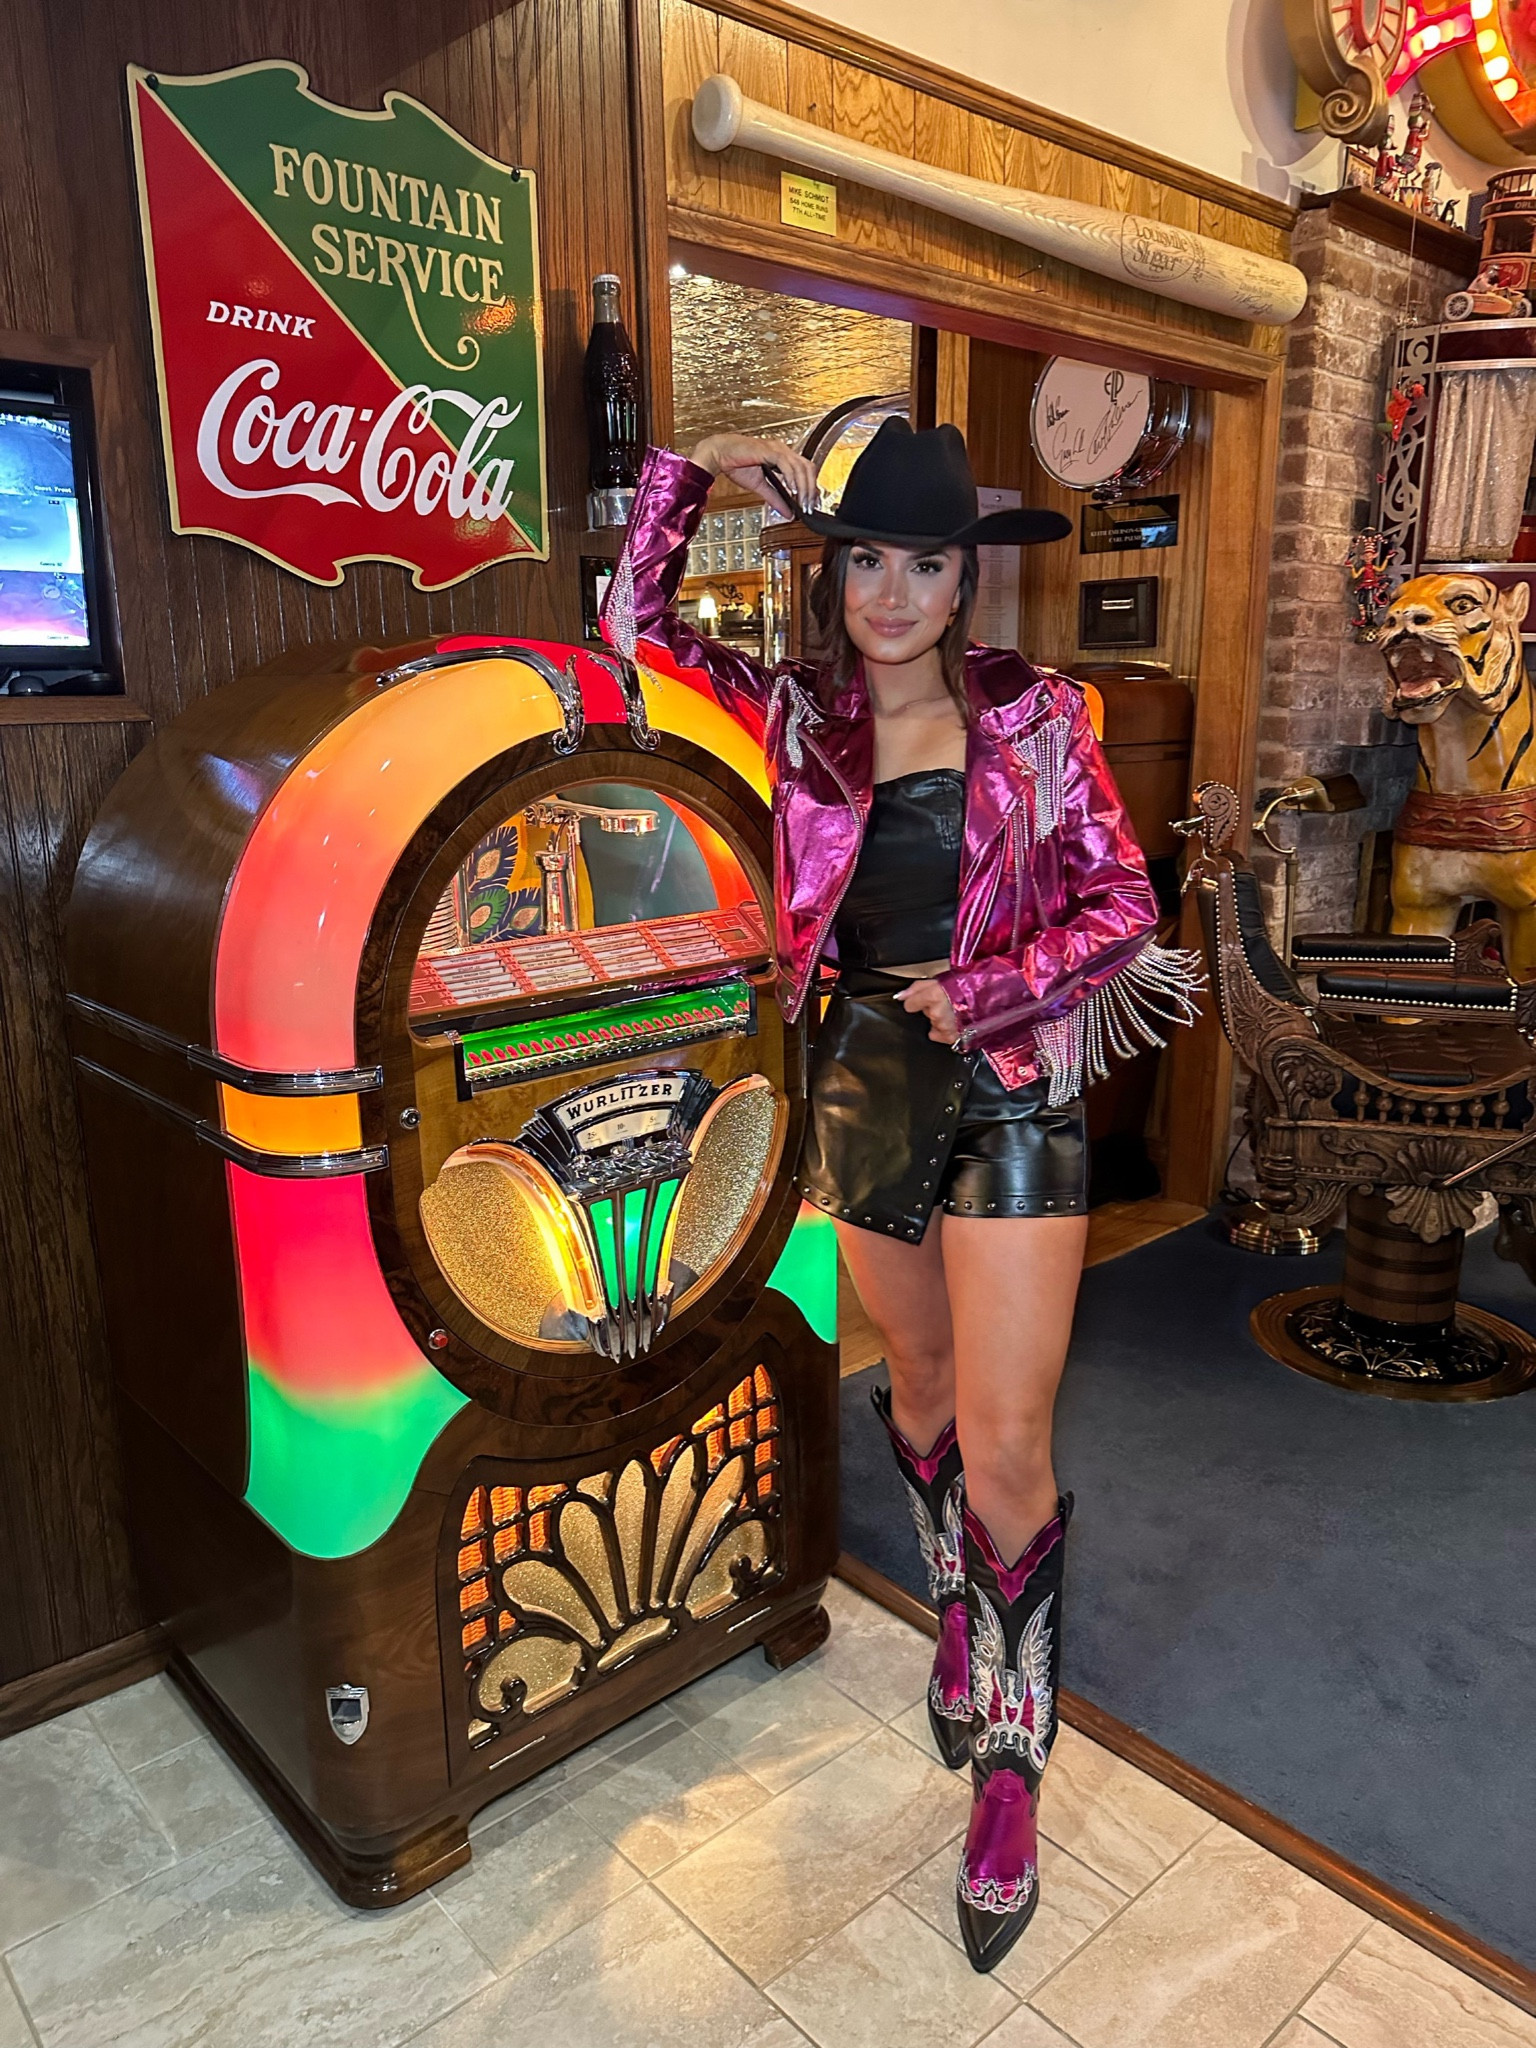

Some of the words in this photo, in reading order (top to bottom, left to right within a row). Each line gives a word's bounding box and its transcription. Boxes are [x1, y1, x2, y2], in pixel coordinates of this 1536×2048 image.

[268, 143, 504, 245] FOUNTAIN
[789, 186, 801, 196] MIKE
[1131, 217, 1188, 253] Louisville
[311, 223, 507, 371] SERVICE
[206, 300, 316, 340] DRINK
[565, 1083, 673, 1121] WURLITZER
